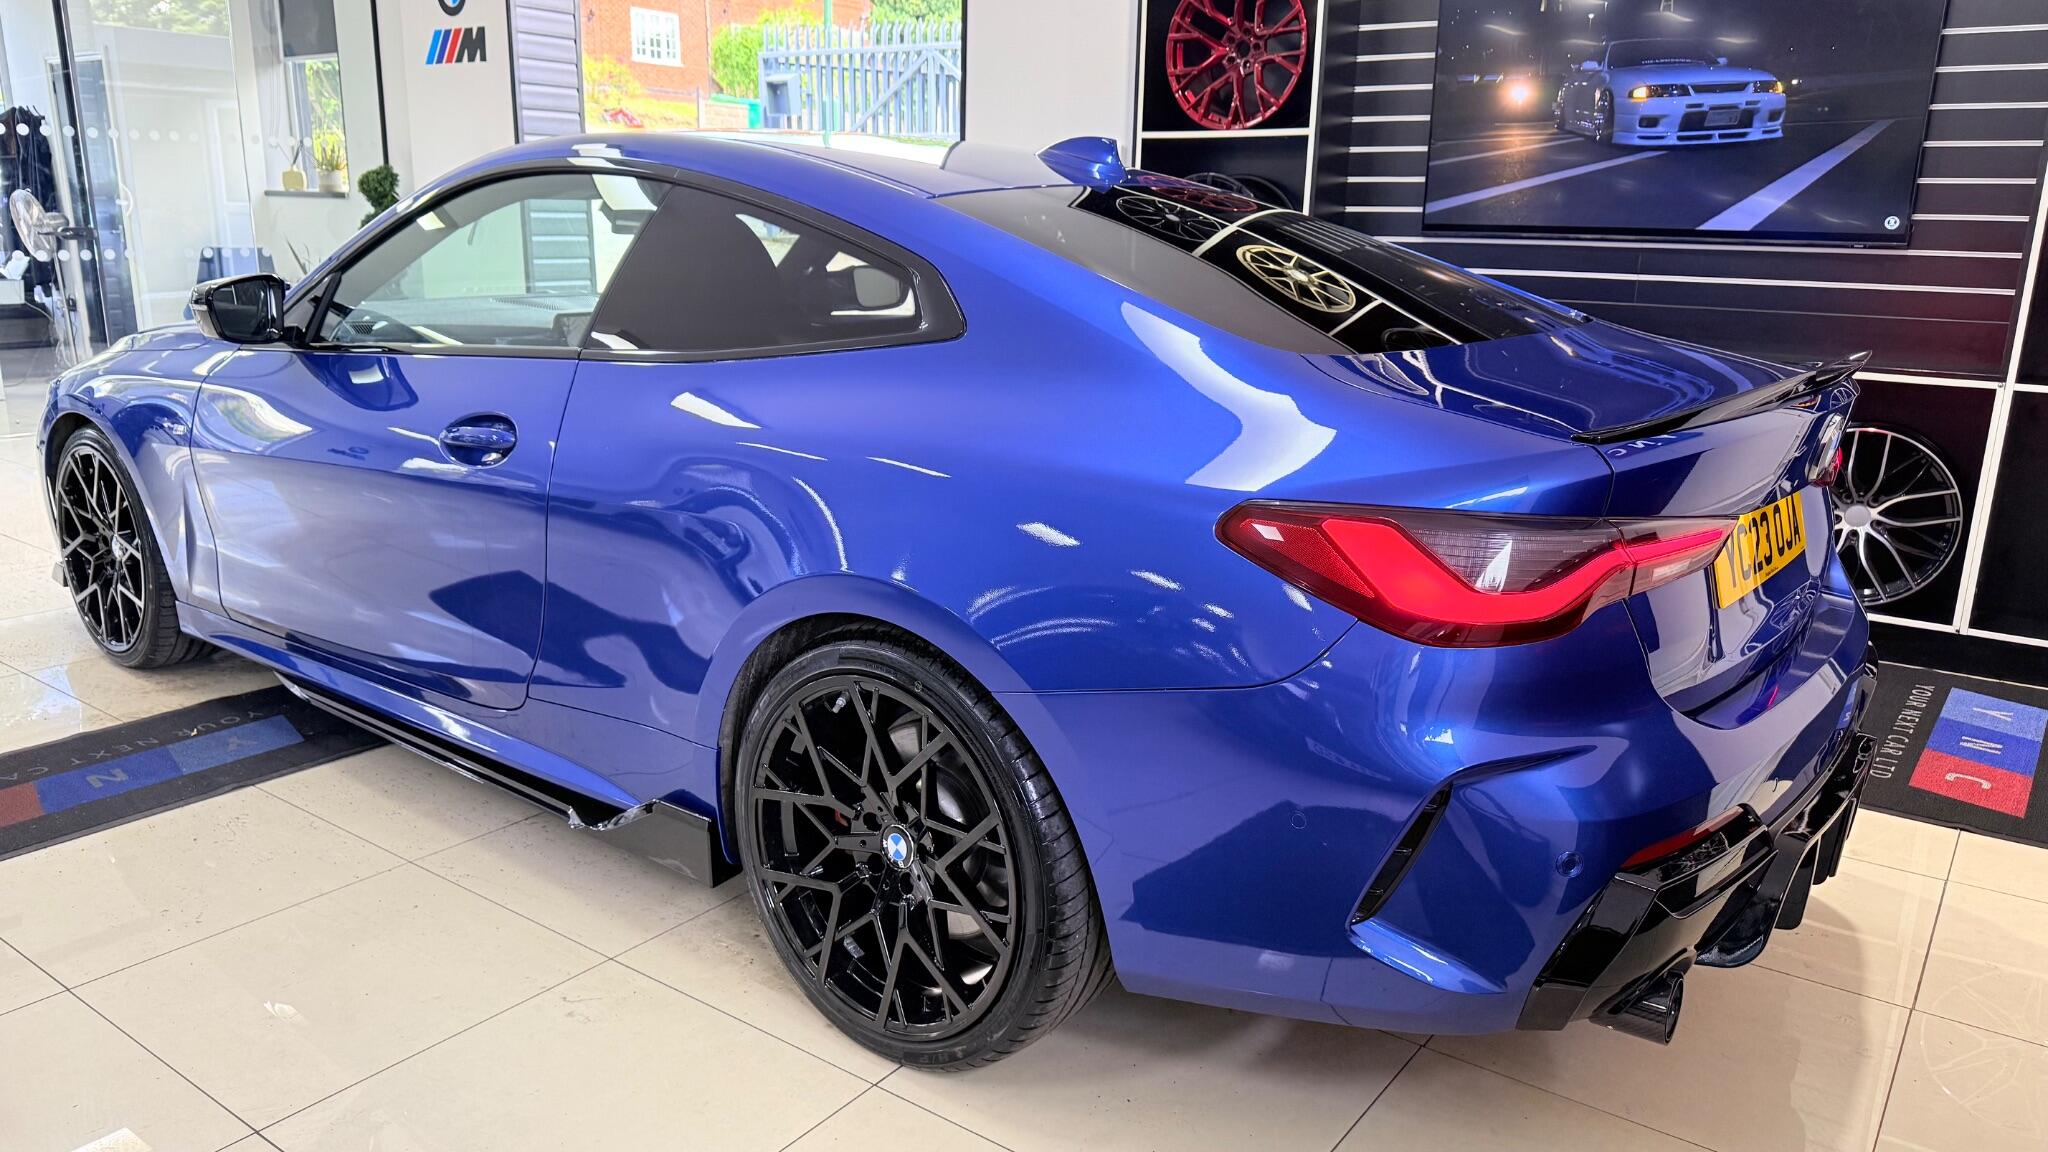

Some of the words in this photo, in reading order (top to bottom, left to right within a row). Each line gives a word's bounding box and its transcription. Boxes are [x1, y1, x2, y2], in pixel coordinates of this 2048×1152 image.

[1724, 511, 1773, 589] YC23
[1772, 494, 1801, 558] OJA
[1904, 684, 1936, 708] YOUR
[172, 711, 263, 737] YOUR
[1892, 708, 1922, 734] NEXT
[70, 737, 159, 765] NEXT
[1879, 734, 1909, 756] CAR
[1870, 756, 1898, 779] LTD
